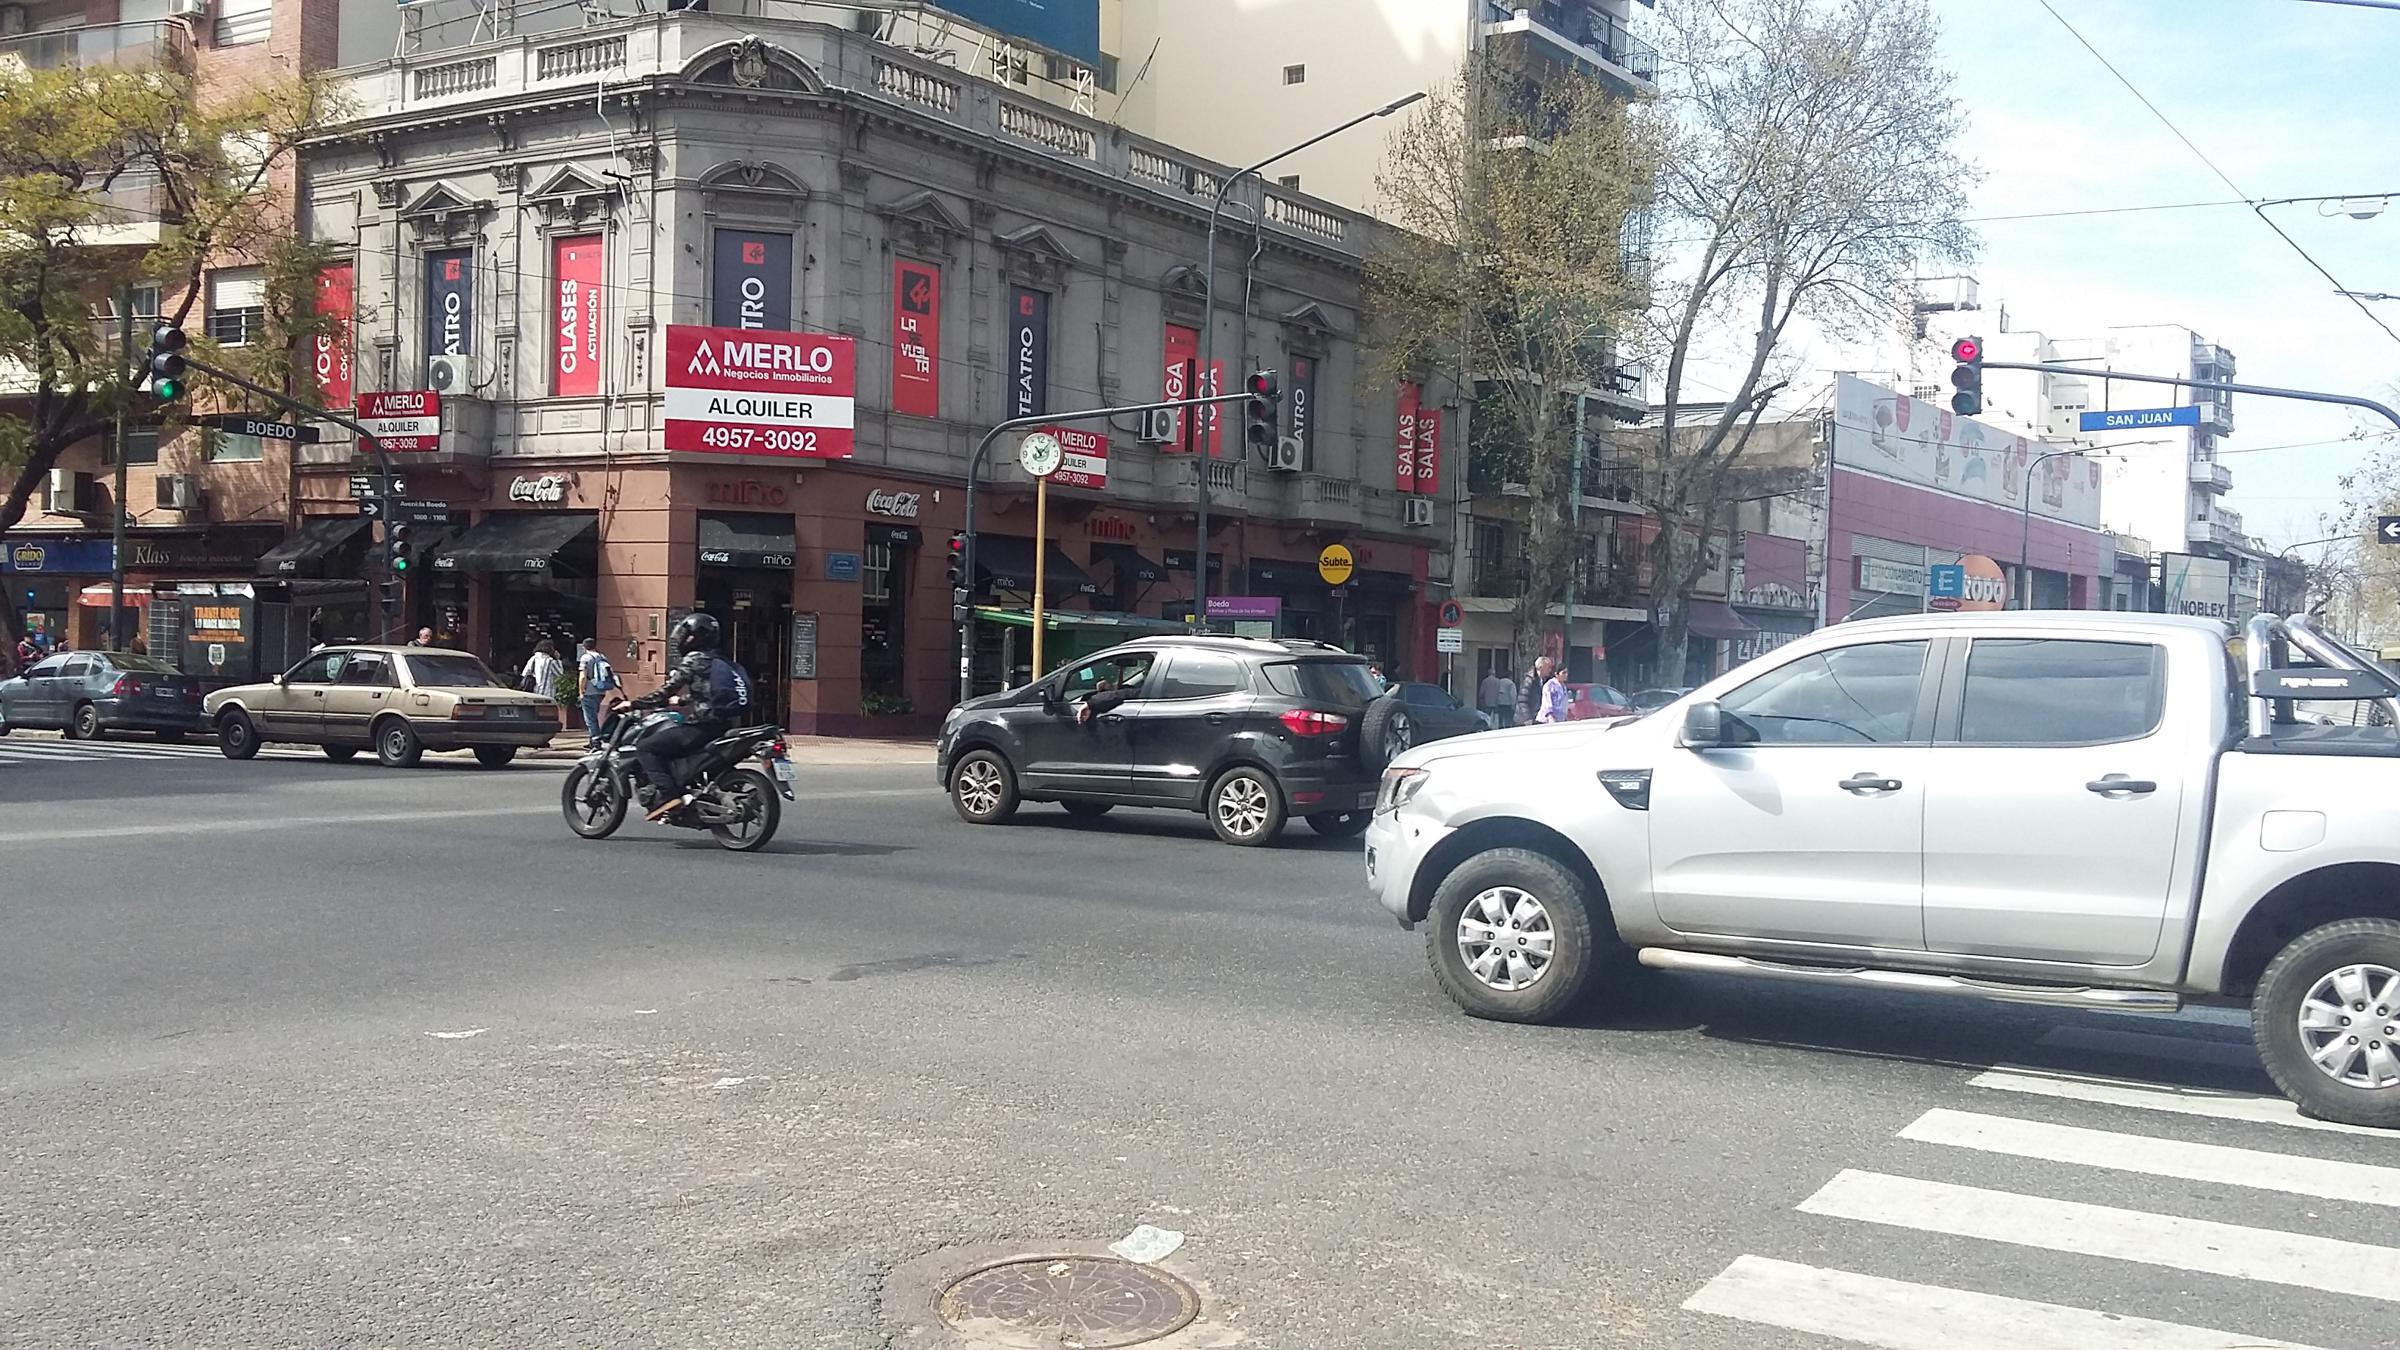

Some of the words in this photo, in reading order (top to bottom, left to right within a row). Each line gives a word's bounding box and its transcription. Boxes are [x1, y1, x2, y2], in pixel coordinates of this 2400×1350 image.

[741, 277, 765, 329] TRO
[445, 292, 461, 355] ATRO
[561, 279, 577, 374] CLASES
[586, 288, 598, 361] ACTUACIÓN
[901, 316, 916, 332] LA
[316, 333, 331, 388] YOG
[724, 341, 832, 373] MERLO
[915, 359, 929, 373] TA
[724, 368, 769, 380] Negocios
[773, 371, 832, 384] Inmobiliarios
[1019, 327, 1034, 415] TEATRO
[385, 394, 424, 409] MERLO
[708, 397, 813, 419] ALQUILER
[1294, 389, 1305, 441] ATRO
[2106, 414, 2133, 426] SAN
[2137, 412, 2173, 425] JUAN
[246, 421, 296, 439] BOEDO
[377, 421, 419, 433] ALQUILER
[702, 427, 817, 451] 4957-3092
[1062, 431, 1096, 449] MERLO
[1398, 415, 1414, 476] SALAS
[1418, 419, 1434, 478] SALAS
[1054, 471, 1088, 484] 4957-3092
[16, 550, 42, 561] GRIDO
[136, 545, 170, 564] Klass
[763, 555, 792, 566] miño
[1324, 556, 1349, 567] Subte
[1939, 570, 1954, 591] E
[2180, 600, 2225, 618] NOBLEX
